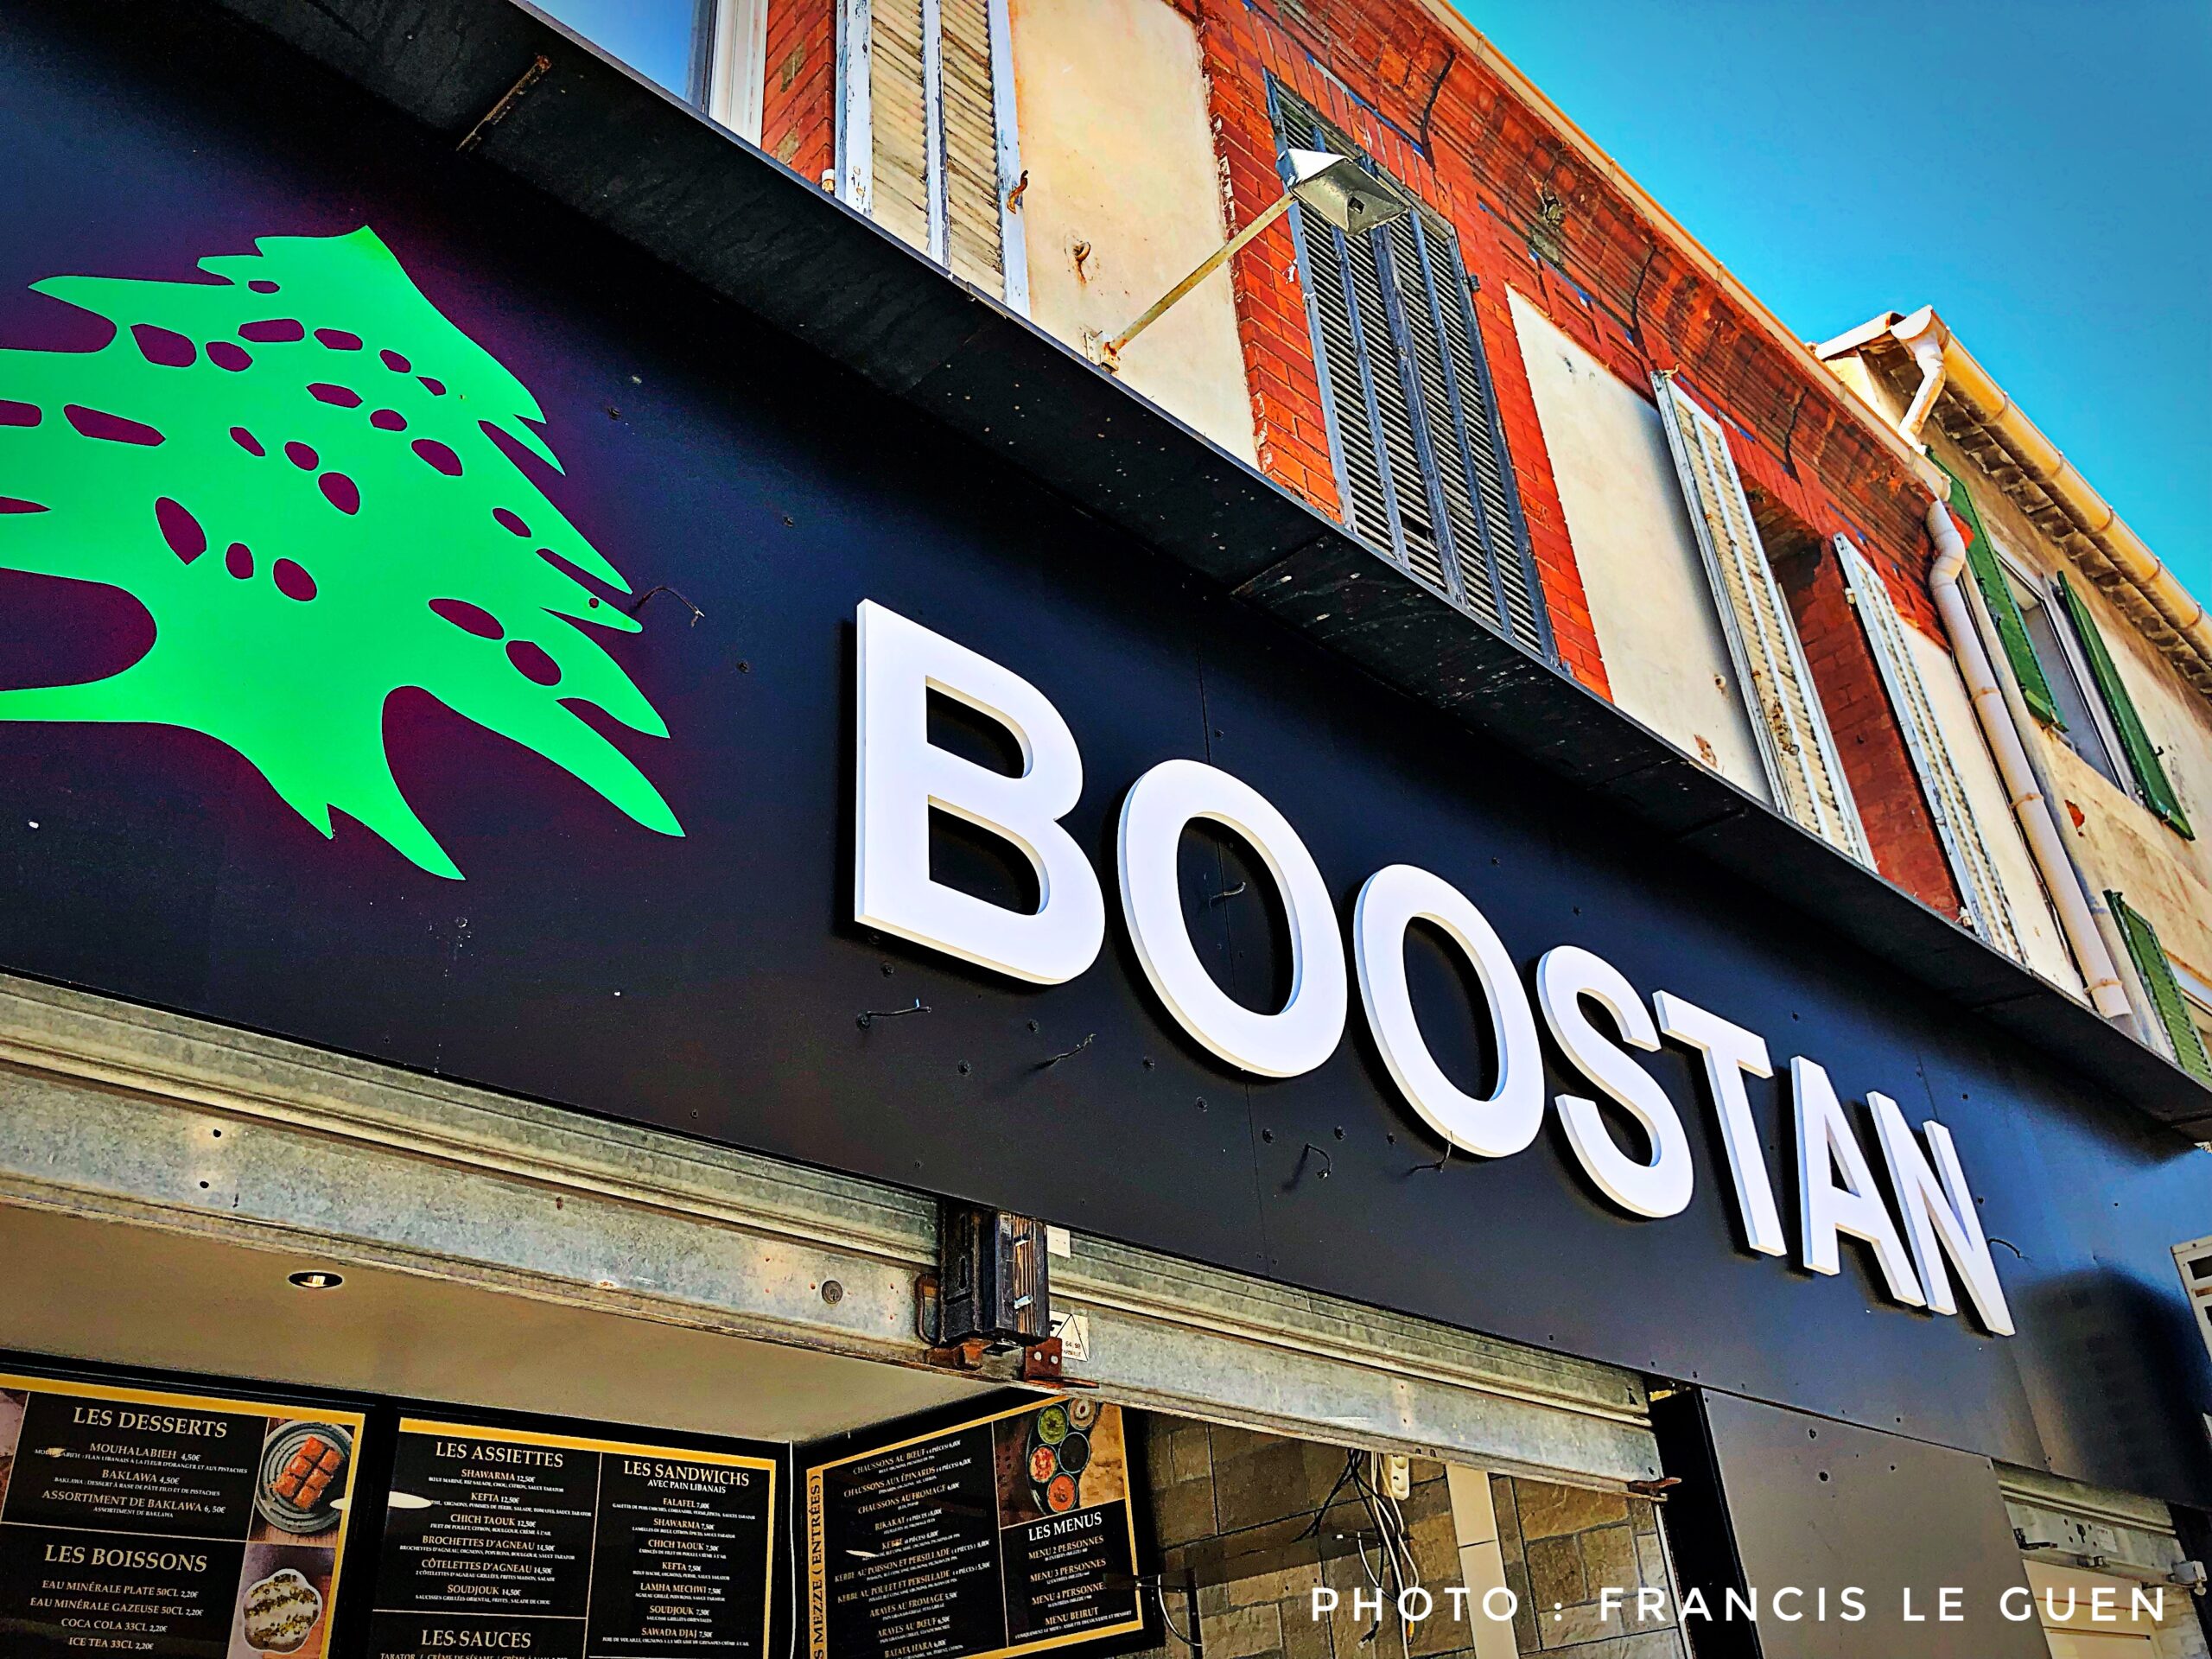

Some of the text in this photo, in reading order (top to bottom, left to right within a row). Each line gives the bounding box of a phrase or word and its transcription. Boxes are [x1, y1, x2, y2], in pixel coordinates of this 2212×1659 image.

[854, 598, 2016, 1337] BOOSTAN
[73, 1407, 227, 1438] LES DESSERTS
[89, 1442, 177, 1459] MOUHALABIEH
[435, 1441, 563, 1468] LES ASSIETTES
[853, 1457, 894, 1476] CHAUSSONS
[894, 1454, 905, 1463] AU
[102, 1469, 157, 1483] BAKLAWA
[461, 1469, 515, 1481] SHAWARMA
[624, 1460, 750, 1487] LES SANDWICHS
[647, 1479, 669, 1489] AVEC
[690, 1484, 727, 1494] LIBANAIS
[843, 1479, 885, 1498] CHAUSSONS
[885, 1477, 900, 1486] AUX
[900, 1466, 936, 1484] ÉPINARDS
[41, 1490, 127, 1505] ASSORTIMENT
[130, 1497, 145, 1507] DE
[148, 1499, 202, 1512] BAKLAWA
[471, 1492, 499, 1503] KEFTA
[663, 1497, 696, 1509] FALAFEL
[857, 1496, 900, 1515] CHAUSSONS
[912, 1484, 947, 1500] FROMAGE
[450, 1514, 481, 1523] CHICH
[484, 1516, 516, 1527] TAOUK
[653, 1518, 701, 1529] SHAWARMA
[874, 1516, 906, 1531] RIKAKAT
[1028, 1511, 1103, 1541] LES MENUS
[423, 1535, 484, 1548] BROCHETTES
[486, 1539, 535, 1550] D'AGNEAU
[648, 1539, 676, 1549] CHICH
[677, 1541, 705, 1550] TAOUK
[1028, 1548, 1052, 1560] MENU
[1058, 1535, 1104, 1553] PERSONNES
[44, 1544, 207, 1573] LES BOISSONS
[422, 1557, 481, 1570] CÔTELETTES
[483, 1562, 532, 1573] D'AGNEAU
[662, 1561, 687, 1571] KEFTA
[899, 1558, 907, 1567] ET
[1030, 1571, 1054, 1583] MENU
[1059, 1558, 1107, 1576] PERSONNES
[41, 1580, 199, 1599] EAU MINÉRALE PLATE 50CL 2,20€
[447, 1584, 499, 1596] SOUDJOUK
[639, 1582, 671, 1592] LAMHA
[672, 1585, 707, 1593] MECHWI
[1031, 1593, 1056, 1605] MENU
[1057, 1591, 1061, 1599] 4
[1061, 1581, 1107, 1599] PERSONNE
[30, 1598, 204, 1617] EAU MINÉRALE GAZEUSE 50CL 2,20€
[908, 1592, 944, 1608] FROMAGE
[649, 1605, 694, 1616] SOUDJOUK
[811, 1580, 824, 1644] MEZZE
[1045, 1613, 1070, 1626] MENU
[1071, 1606, 1099, 1624] BEIRUT
[60, 1618, 168, 1633] COCA COLA 33CL 2,20€
[641, 1627, 677, 1637] SAWADA
[678, 1629, 697, 1638] DJAJ
[68, 1637, 154, 1650] ICE TEA 33CL 2,20€
[421, 1630, 531, 1649] LES SAUCES
